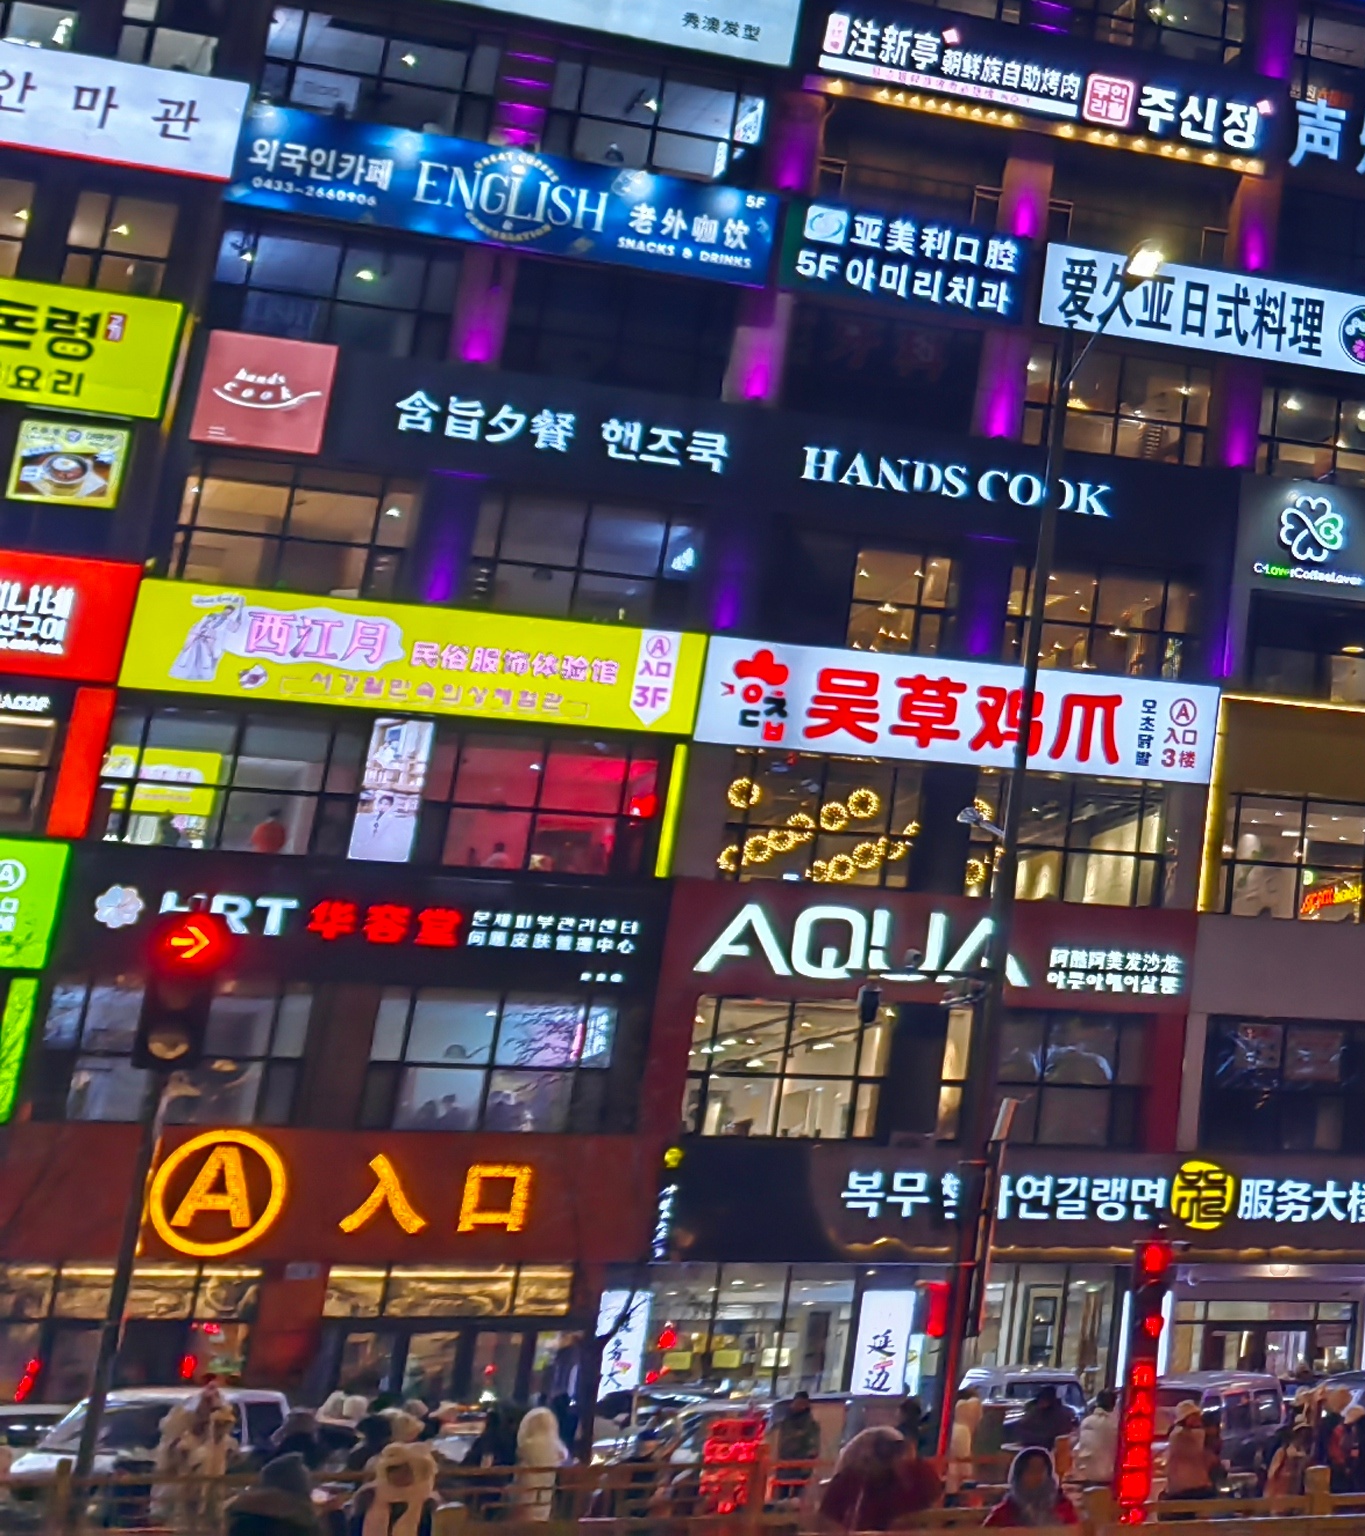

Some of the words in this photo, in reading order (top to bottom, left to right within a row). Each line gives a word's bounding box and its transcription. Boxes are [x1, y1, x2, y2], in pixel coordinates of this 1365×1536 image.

[847, 19, 941, 71] 注新亭
[942, 49, 1082, 100] 朝鲜族自助烤肉
[1137, 85, 1259, 149] 주신정
[248, 139, 394, 191] 외국인카페
[412, 161, 609, 233] ENGLISH
[745, 195, 766, 208] 5F
[627, 202, 752, 250] 老外咖饮
[850, 215, 1018, 274] 亚美利口腔
[616, 236, 675, 258] SNACKS
[699, 250, 752, 270] DRINKS
[796, 249, 837, 280] 5F
[846, 262, 1011, 317] 아미리치과
[396, 389, 576, 454] 含旨夕餐
[600, 417, 729, 474] 핸즈쿡
[801, 445, 968, 499] HANDS
[244, 610, 392, 663] 西江月
[641, 660, 672, 677] 入口
[633, 684, 669, 709] 3F
[803, 666, 1122, 765] 吴草鸡爪
[1161, 748, 1196, 769] 3楼
[1163, 726, 1197, 746] 入口
[307, 897, 463, 949] 华容堂
[466, 929, 636, 955] 问题皮肤管理中心
[692, 902, 1029, 988] AQUA
[339, 1154, 532, 1235] 入口
